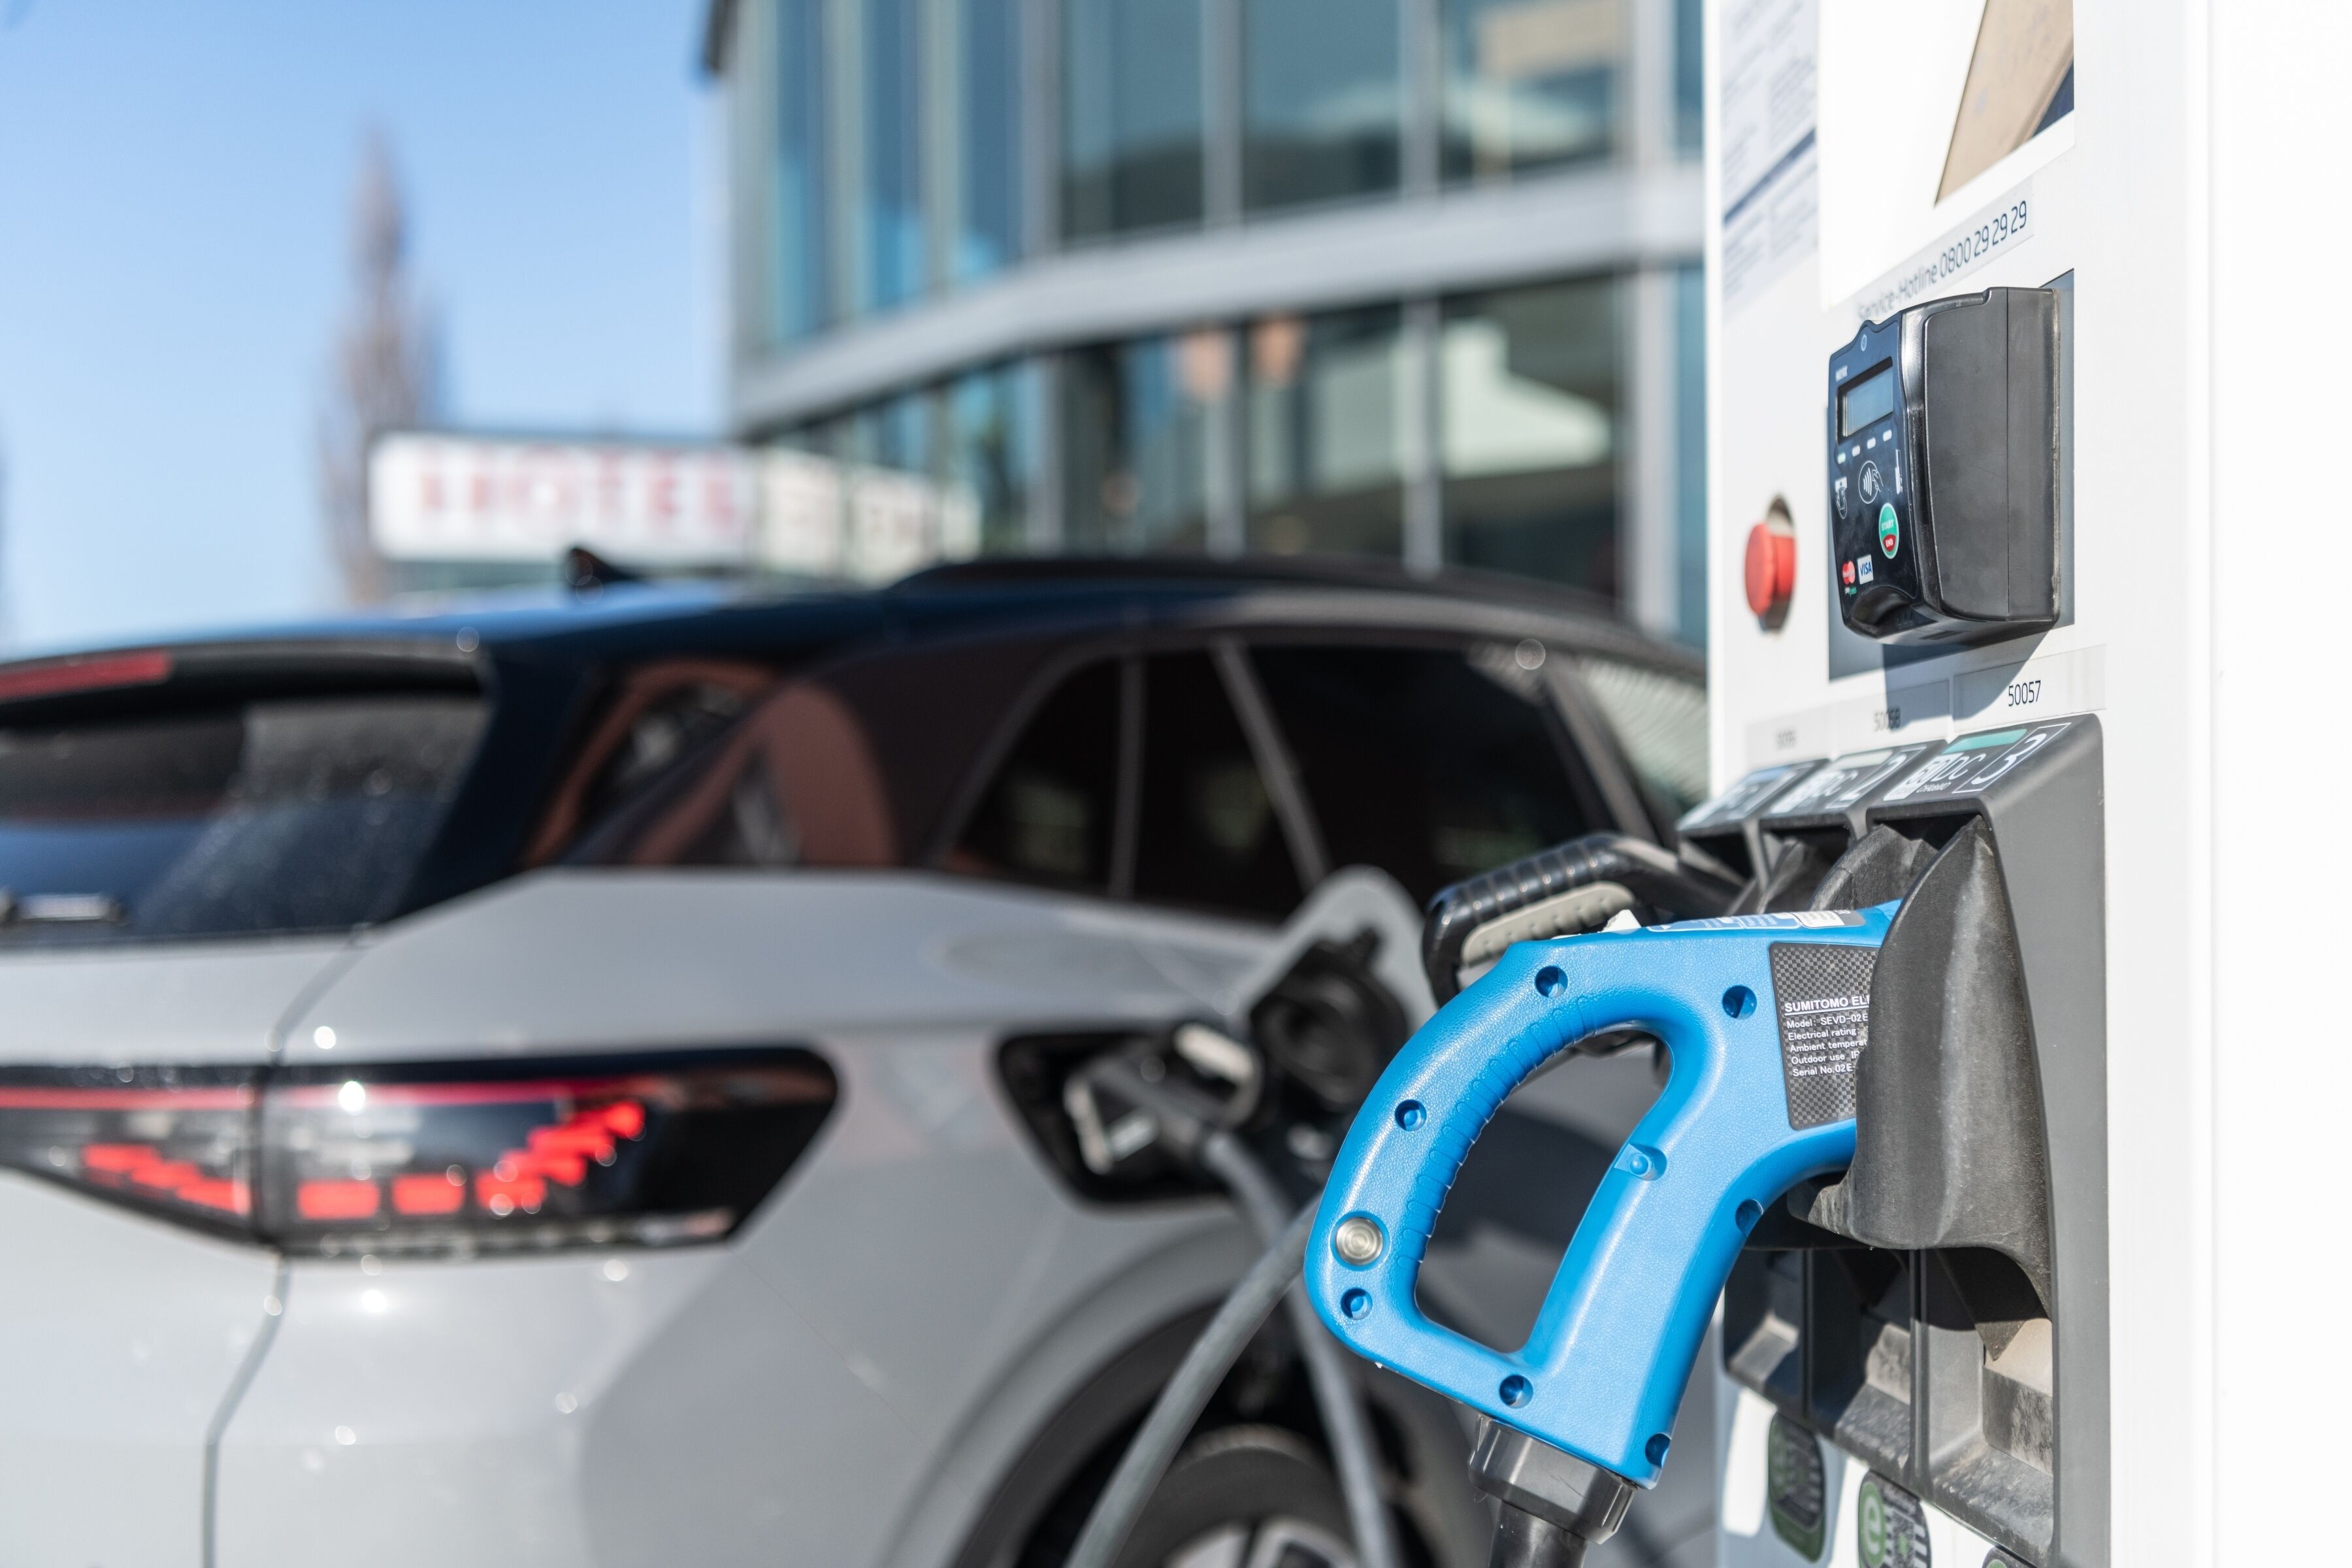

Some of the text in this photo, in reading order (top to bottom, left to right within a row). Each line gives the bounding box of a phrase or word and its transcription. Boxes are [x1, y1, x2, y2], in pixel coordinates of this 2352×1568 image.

[1857, 200, 2027, 319] Service-Hotline 0800 29 29 29
[1882, 519, 1894, 531] START
[1860, 561, 1872, 576] VISA
[2008, 679, 2041, 706] 50057
[1970, 733, 2047, 785] 3
[1930, 753, 1987, 783] DC
[1784, 996, 1849, 1013] SUMITOMO
[1786, 1013, 1869, 1029] Model: SEVD-02E
[1788, 1027, 1860, 1041] Electrical rating:
[1789, 1042, 1826, 1053] Ambient
[1791, 1054, 1827, 1065] Outdoor
[1792, 1066, 1818, 1077] Serial
